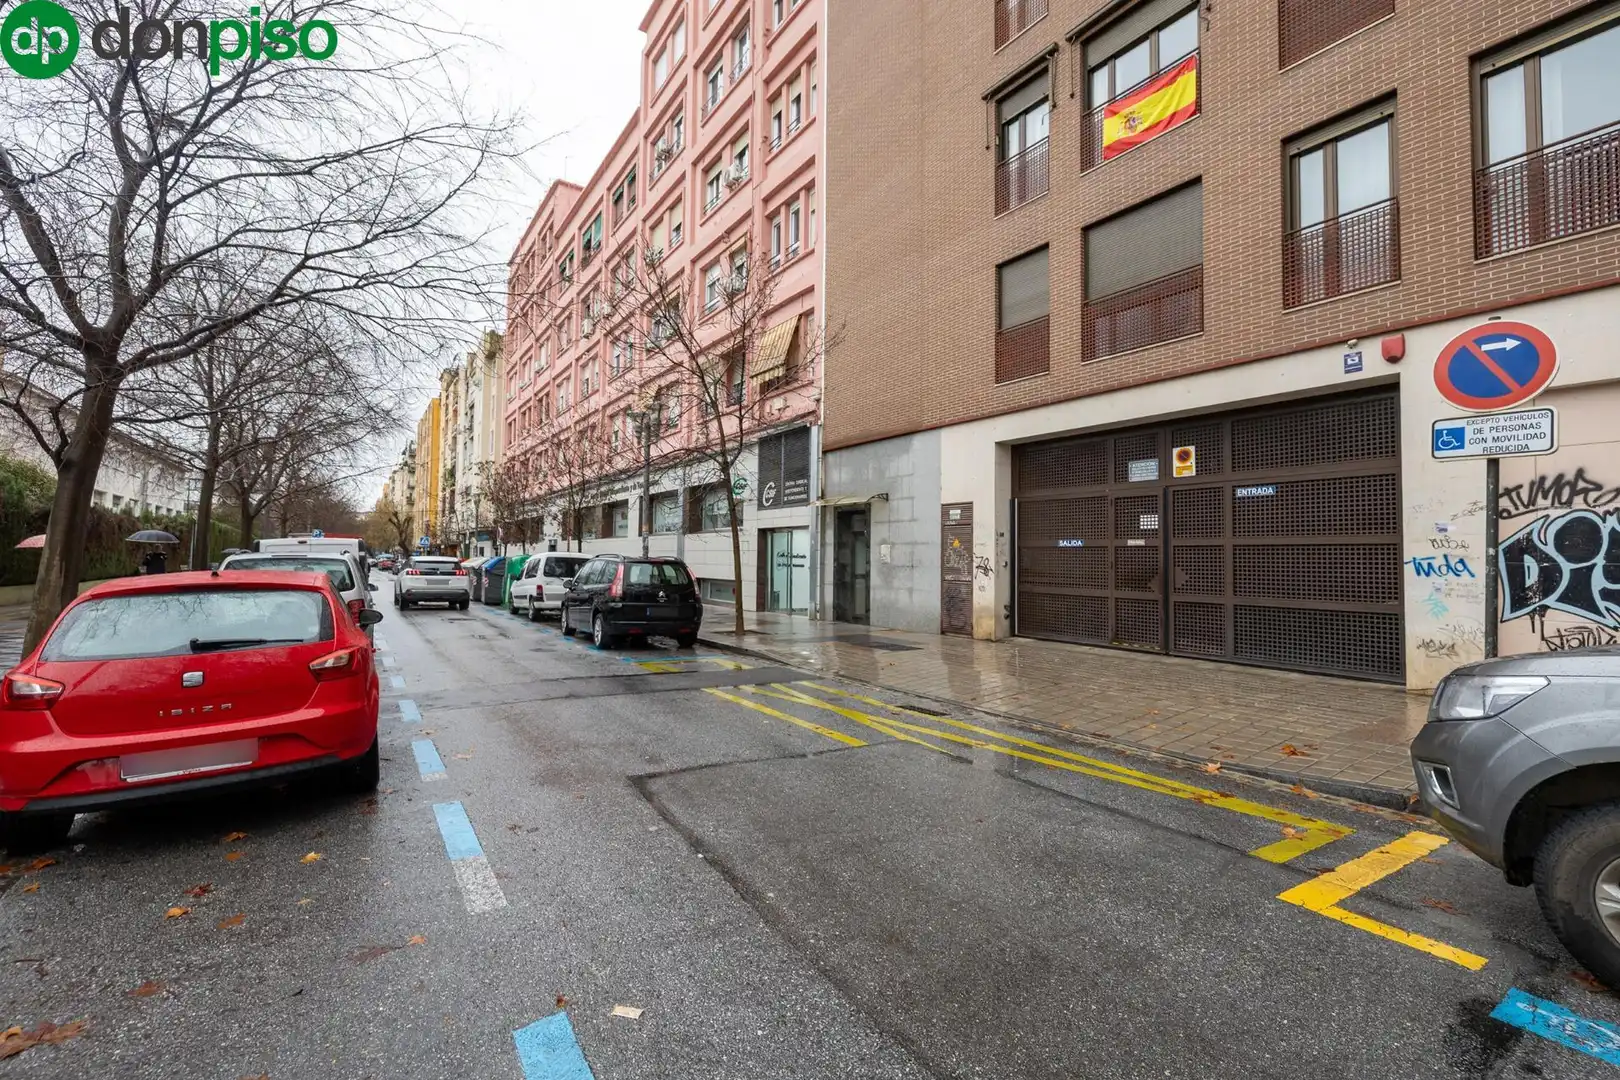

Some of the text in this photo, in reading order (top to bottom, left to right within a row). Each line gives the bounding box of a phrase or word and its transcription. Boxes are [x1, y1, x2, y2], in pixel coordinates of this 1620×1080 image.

[1466, 416, 1501, 426] EXCEPTO
[1472, 421, 1542, 436] DE PERSONAS
[1468, 431, 1547, 446] CON MOVILIDAD
[1482, 443, 1530, 454] REDUCIDA
[1237, 487, 1274, 497] ENTRADA
[1059, 539, 1083, 547] SALIDA
[159, 703, 232, 717] IBIZA
